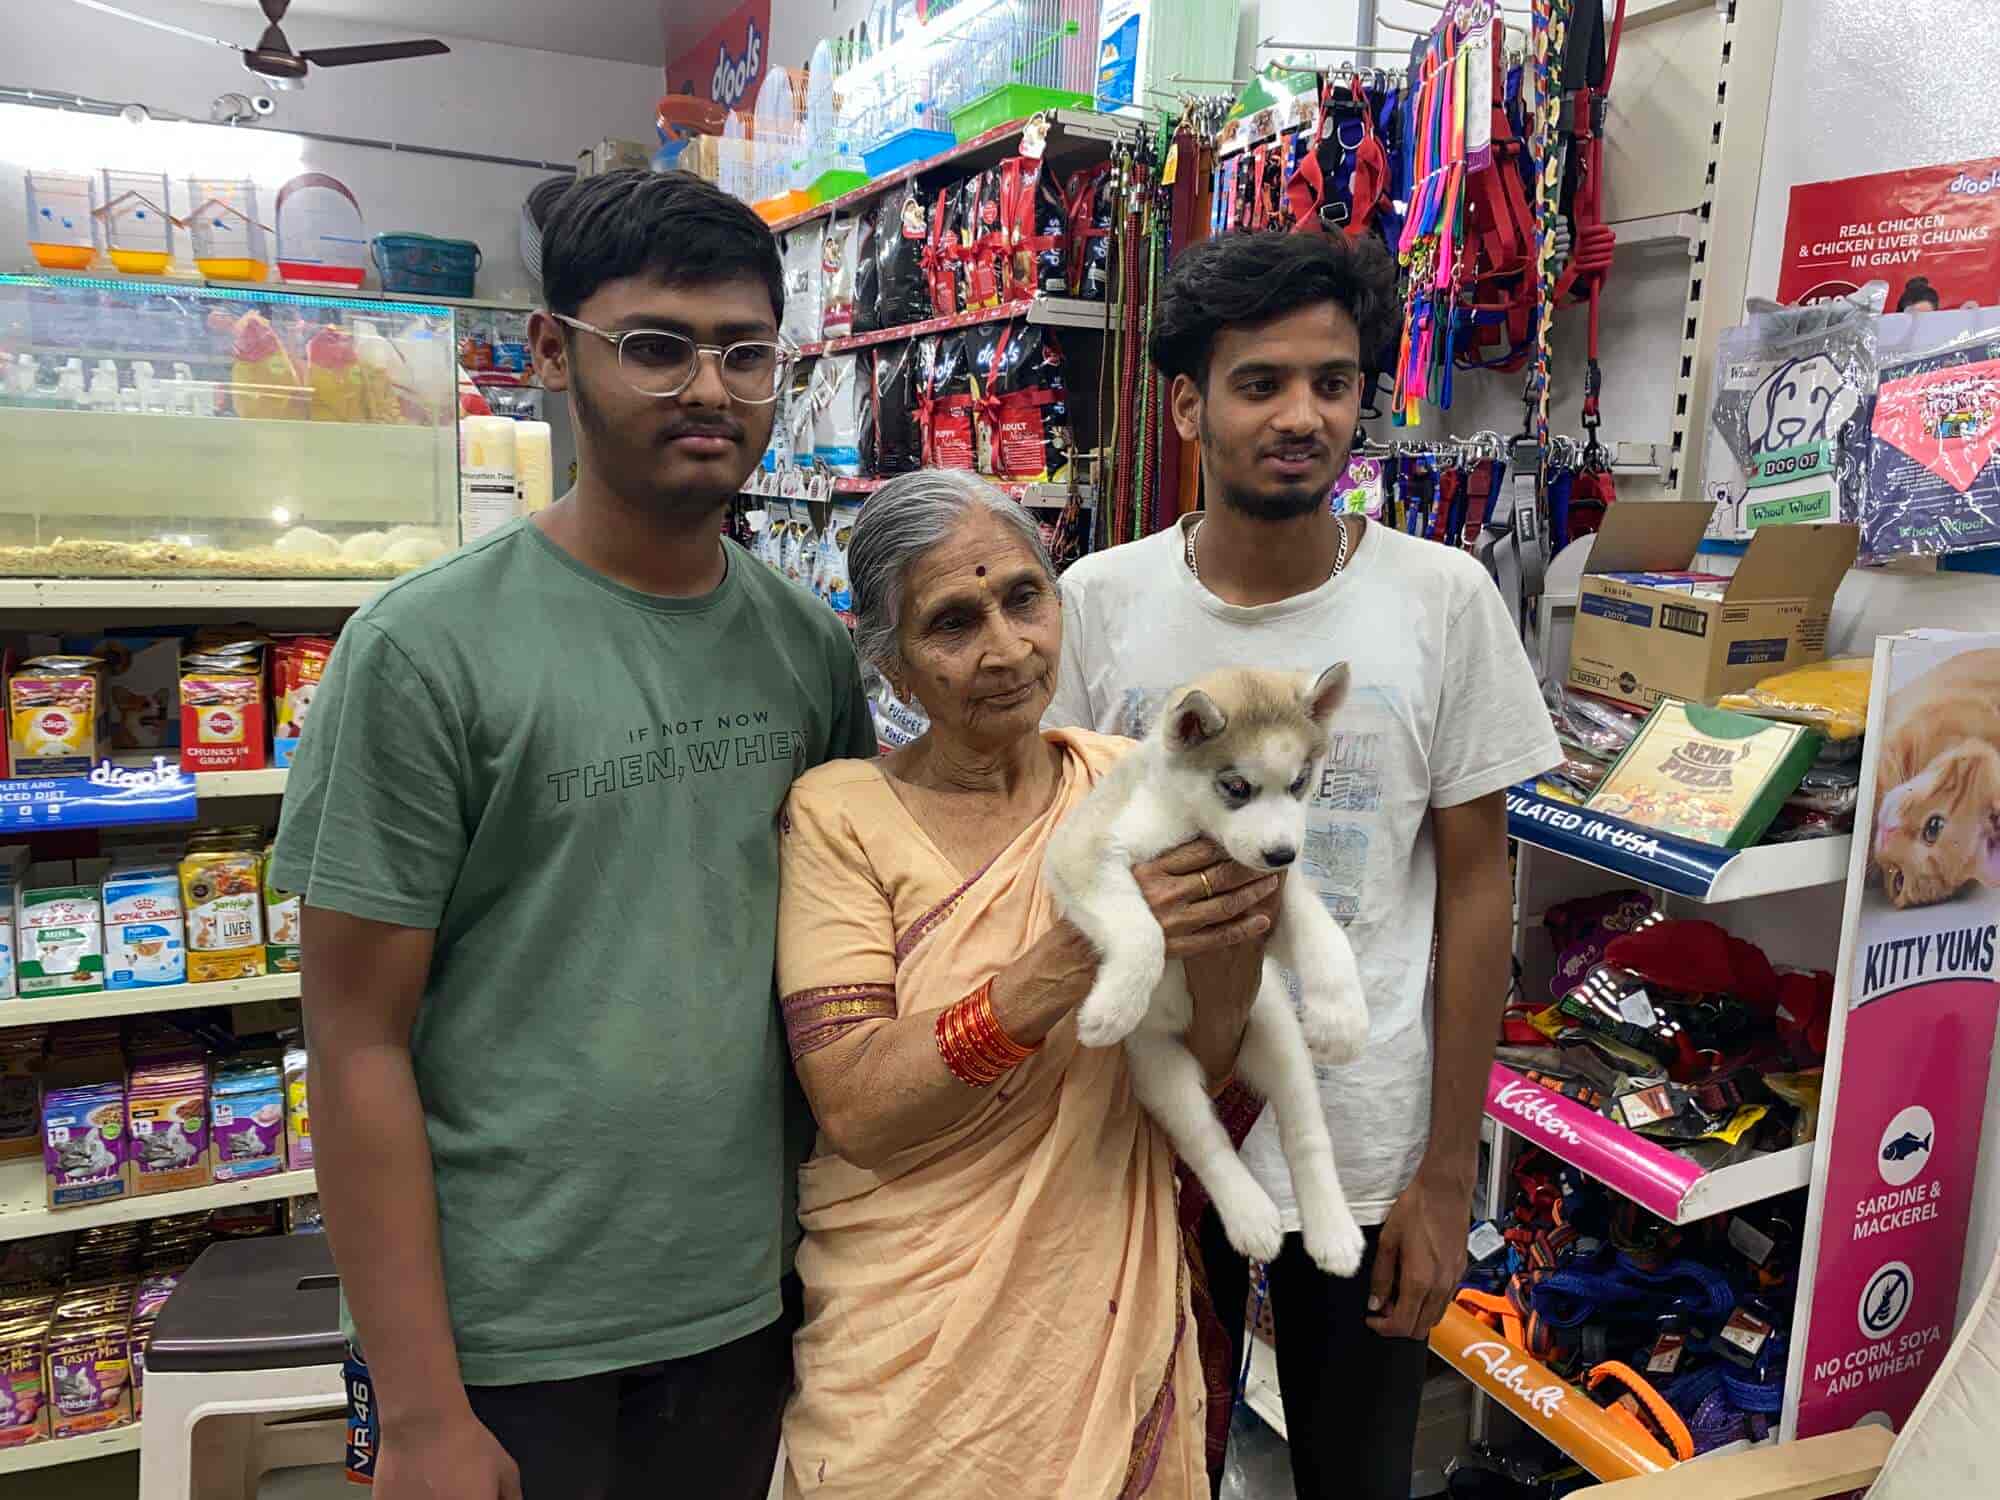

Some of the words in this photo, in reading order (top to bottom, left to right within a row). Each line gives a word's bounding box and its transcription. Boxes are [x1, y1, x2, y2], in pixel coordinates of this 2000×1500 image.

[711, 23, 761, 105] drools
[1799, 246, 1809, 257] &
[1812, 240, 1876, 256] CHICKEN
[1878, 233, 1918, 249] LIVER
[1921, 225, 1990, 245] CHUNKS
[1839, 223, 1873, 238] REAL
[1878, 215, 1946, 233] CHICKEN
[1851, 254, 1868, 268] IN
[1870, 249, 1922, 265] GRAVY
[1765, 458, 1797, 475] DOG
[629, 727, 649, 744] IF
[661, 719, 704, 737] NOT
[717, 711, 768, 729] NOW
[187, 747, 234, 756] CHUNKS
[199, 756, 237, 765] GRAVY
[31, 781, 56, 790] AND
[1657, 756, 1733, 786] PIZZA
[35, 791, 65, 801] DIET
[1581, 819, 1612, 841] IN
[1610, 829, 1660, 858] USA
[223, 921, 252, 936] LIVER
[1862, 935, 1931, 996] KITTY
[1935, 924, 1996, 973] YUMS
[1493, 1080, 1581, 1146] Kitten
[1855, 1184, 1926, 1219] SARDINE
[1930, 1180, 1942, 1198] &
[1853, 1202, 1939, 1241] MACKEREL
[62, 1351, 99, 1366] TASTY
[1814, 1357, 1841, 1382] NO
[1844, 1340, 1893, 1371] CORN,
[1899, 1326, 1942, 1350] SOYA
[1461, 1341, 1567, 1419] Adult
[1826, 1370, 1863, 1397] AND
[1867, 1349, 1924, 1384] WHEAT
